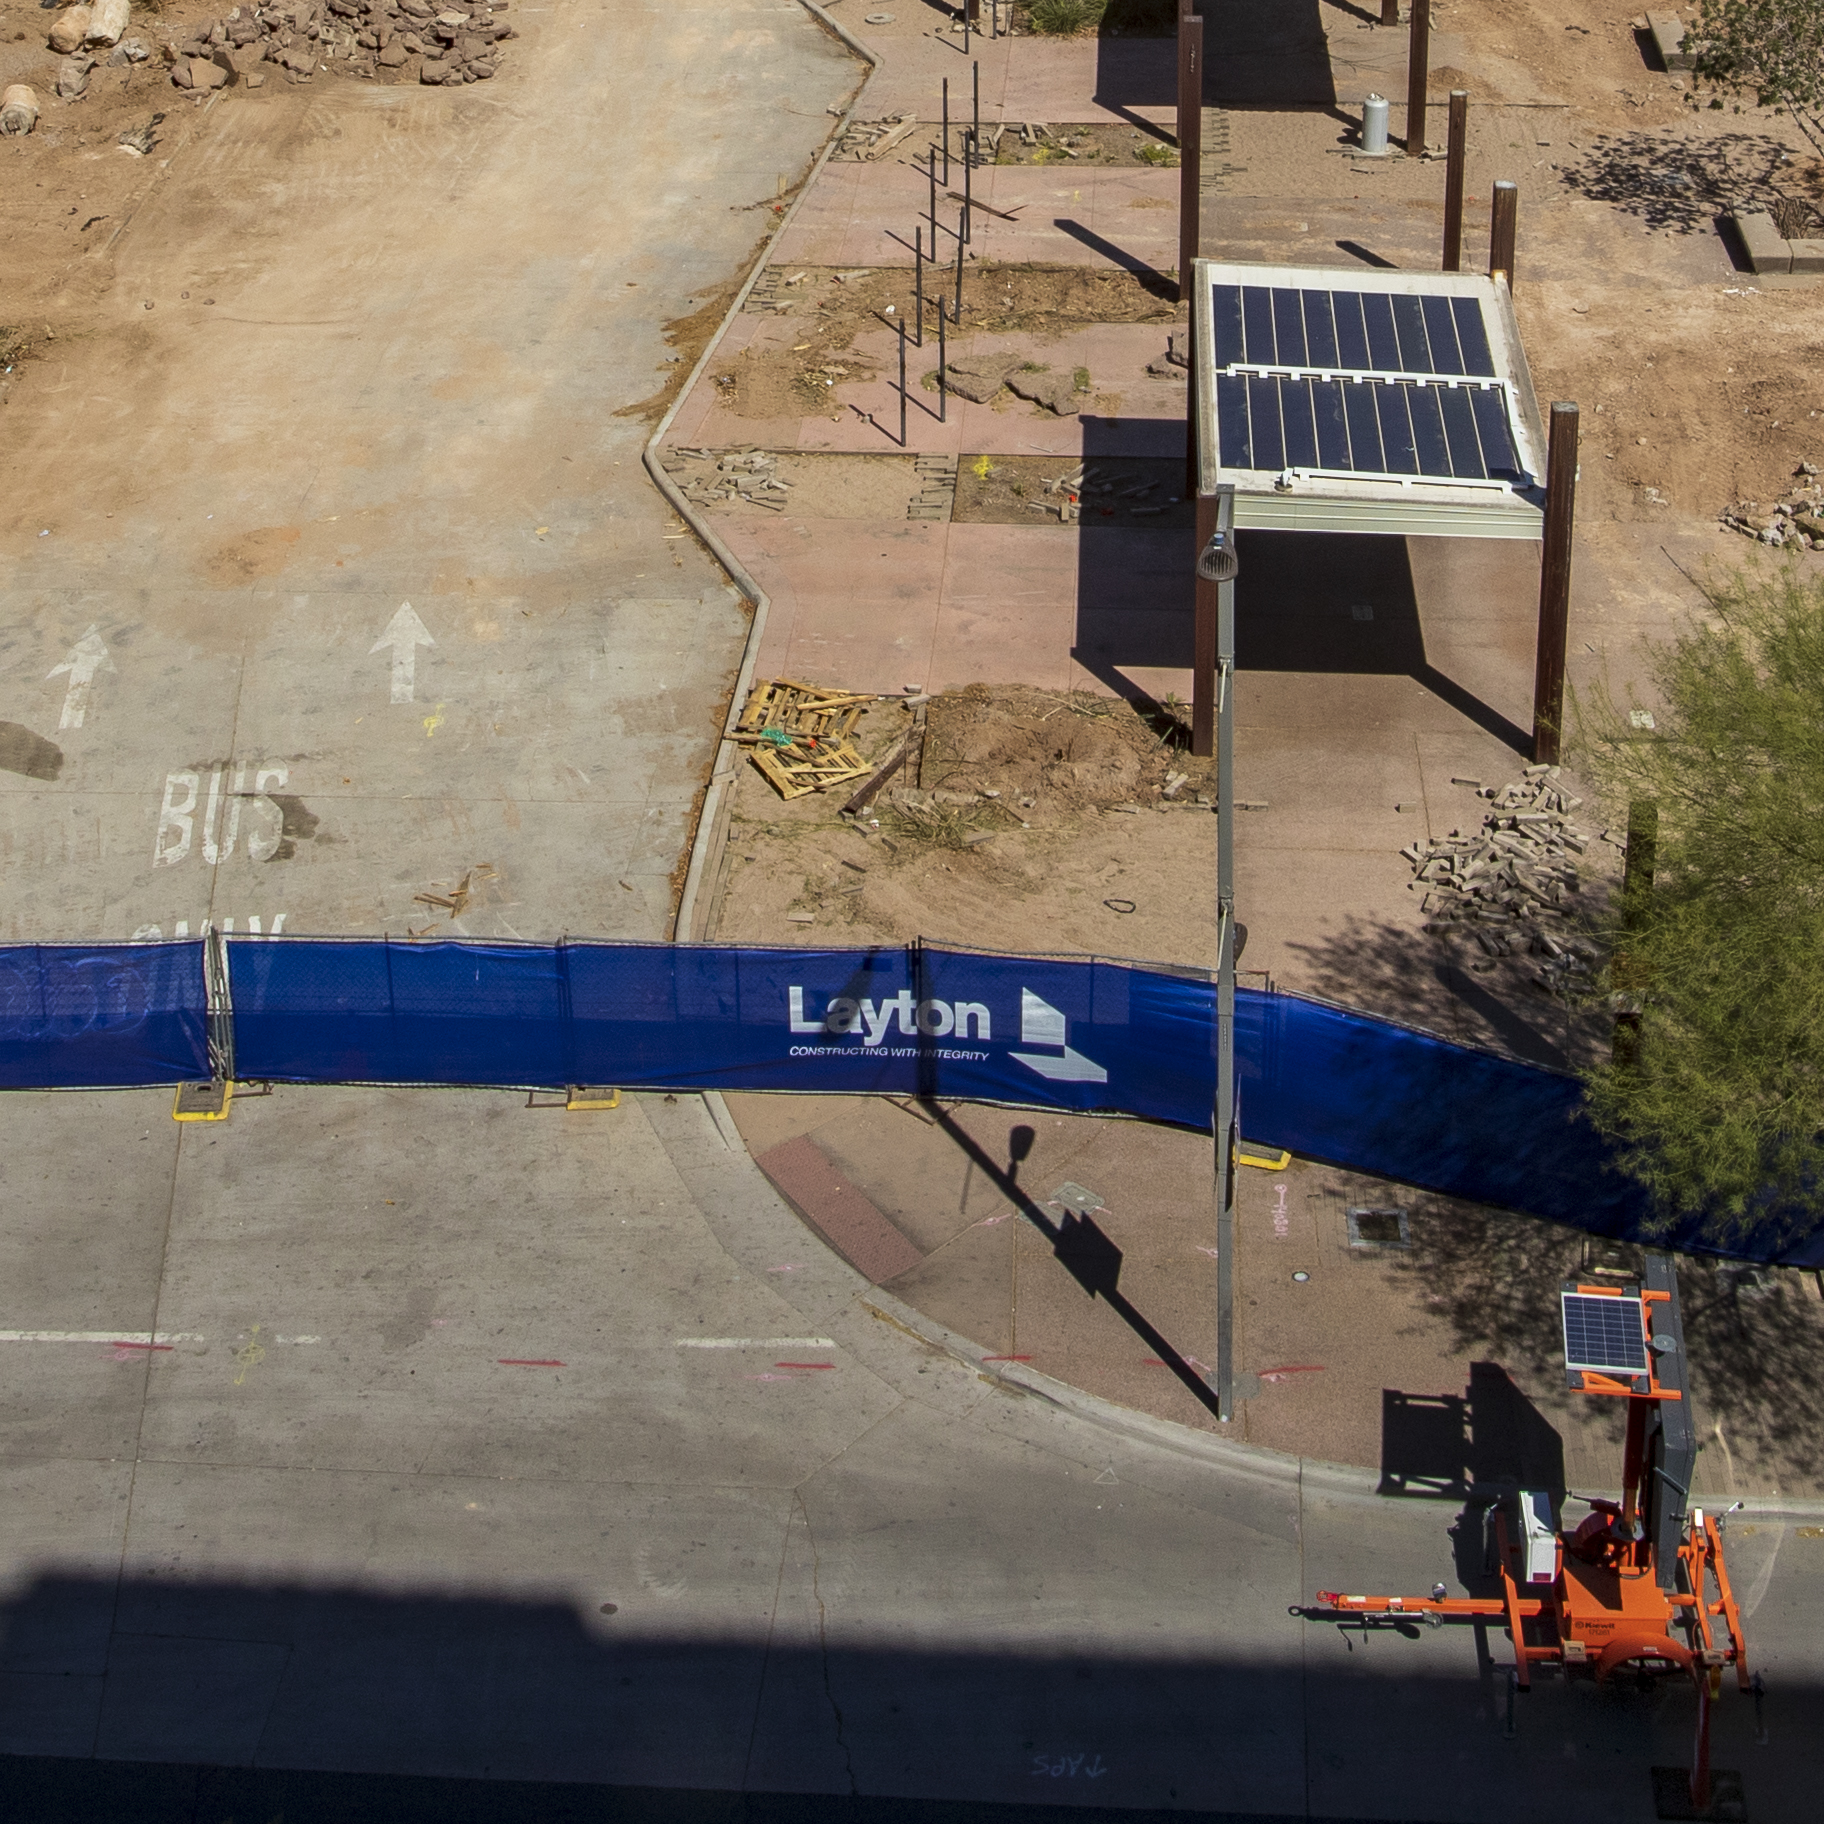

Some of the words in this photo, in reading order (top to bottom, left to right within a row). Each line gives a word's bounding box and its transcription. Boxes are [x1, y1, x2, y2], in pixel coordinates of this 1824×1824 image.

[152, 757, 291, 868] BUS
[788, 985, 991, 1048] Layton
[788, 1046, 887, 1059] CONSTRUCTING
[889, 1047, 923, 1060] WITH
[924, 1048, 991, 1062] INTEGRITY
